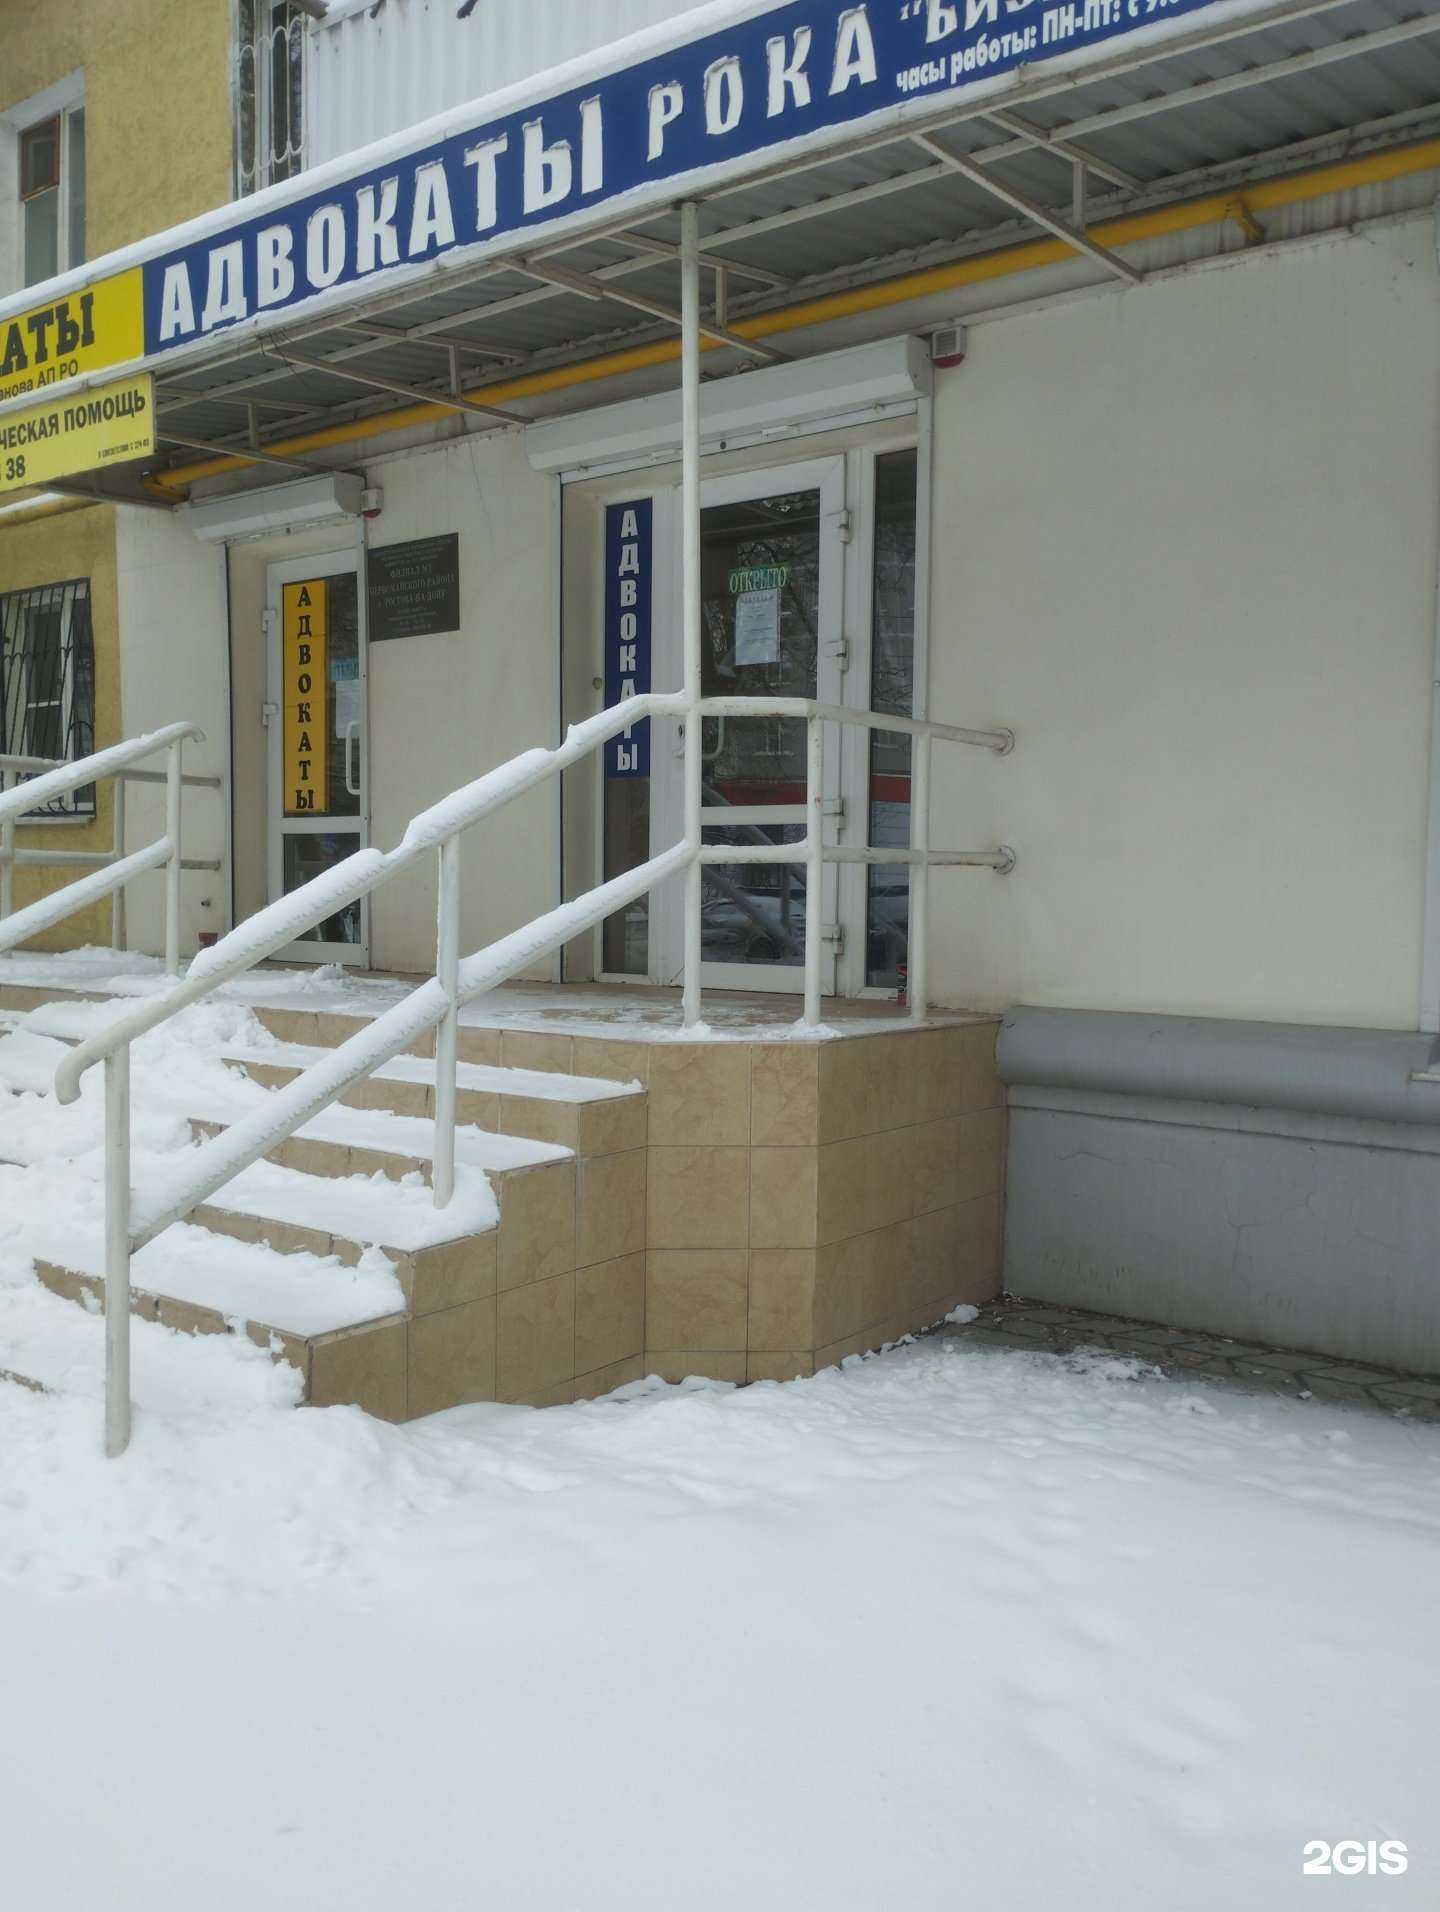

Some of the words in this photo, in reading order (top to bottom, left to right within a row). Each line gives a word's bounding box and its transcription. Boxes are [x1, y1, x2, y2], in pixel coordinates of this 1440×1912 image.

[896, 57, 946, 93] часы
[950, 25, 1037, 85] работы:
[160, 95, 604, 342] АДВОКАТЫ
[647, 3, 877, 162] РОКА
[37, 366, 55, 389] АП
[60, 359, 78, 381] РО
[64, 389, 146, 432] ПОМОЩЬ
[5, 454, 26, 481] 38
[729, 566, 787, 593] ОТКРЫТО
[296, 586, 314, 810] АДВОКАТЫ
